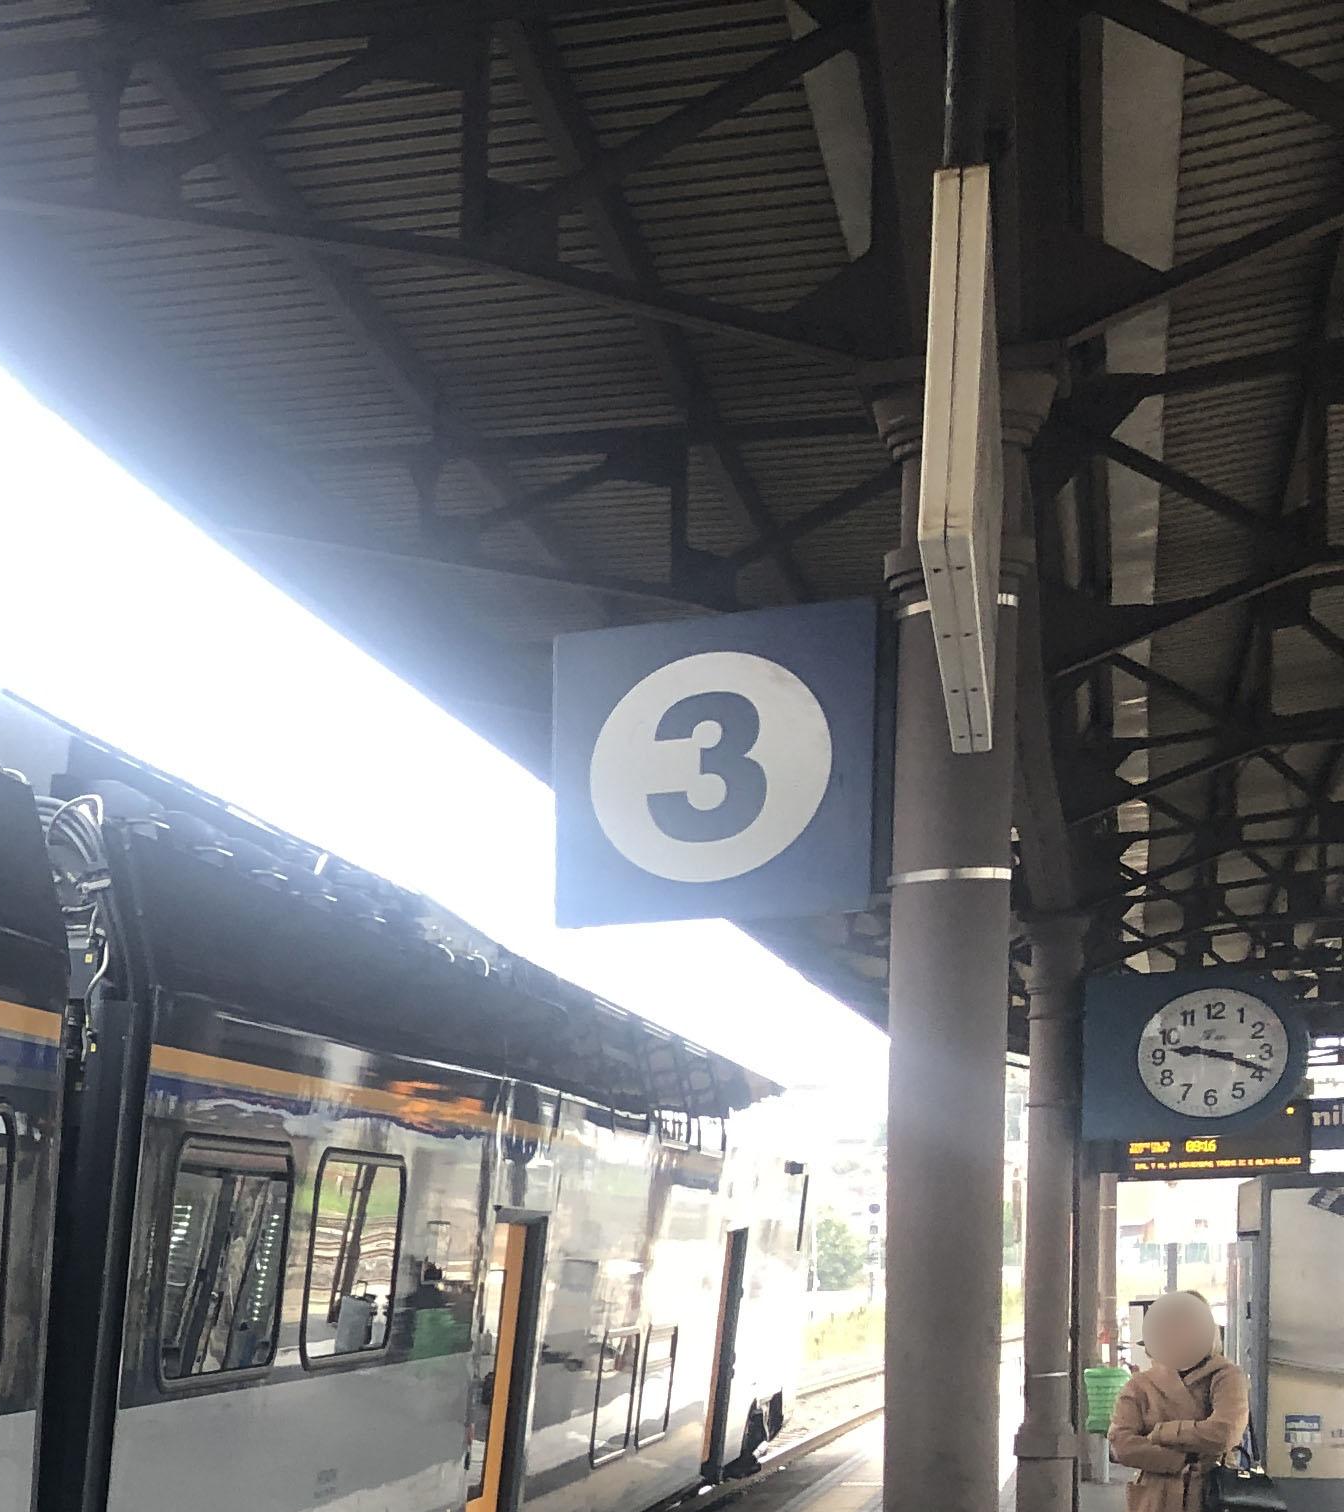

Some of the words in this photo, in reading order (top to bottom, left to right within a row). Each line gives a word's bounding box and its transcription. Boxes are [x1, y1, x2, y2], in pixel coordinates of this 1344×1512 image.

[646, 690, 767, 842] 3
[1180, 1009, 1195, 1026] 11
[1204, 1001, 1226, 1020] 12
[1237, 1007, 1246, 1024] 1
[1159, 1027, 1180, 1045] 10
[1251, 1021, 1265, 1039] 2
[1151, 1048, 1166, 1066] 9
[1259, 1043, 1273, 1060] 3
[1160, 1069, 1174, 1086] 8
[1180, 1083, 1192, 1101] 7
[1203, 1088, 1218, 1106] 6
[1231, 1082, 1245, 1099] 5
